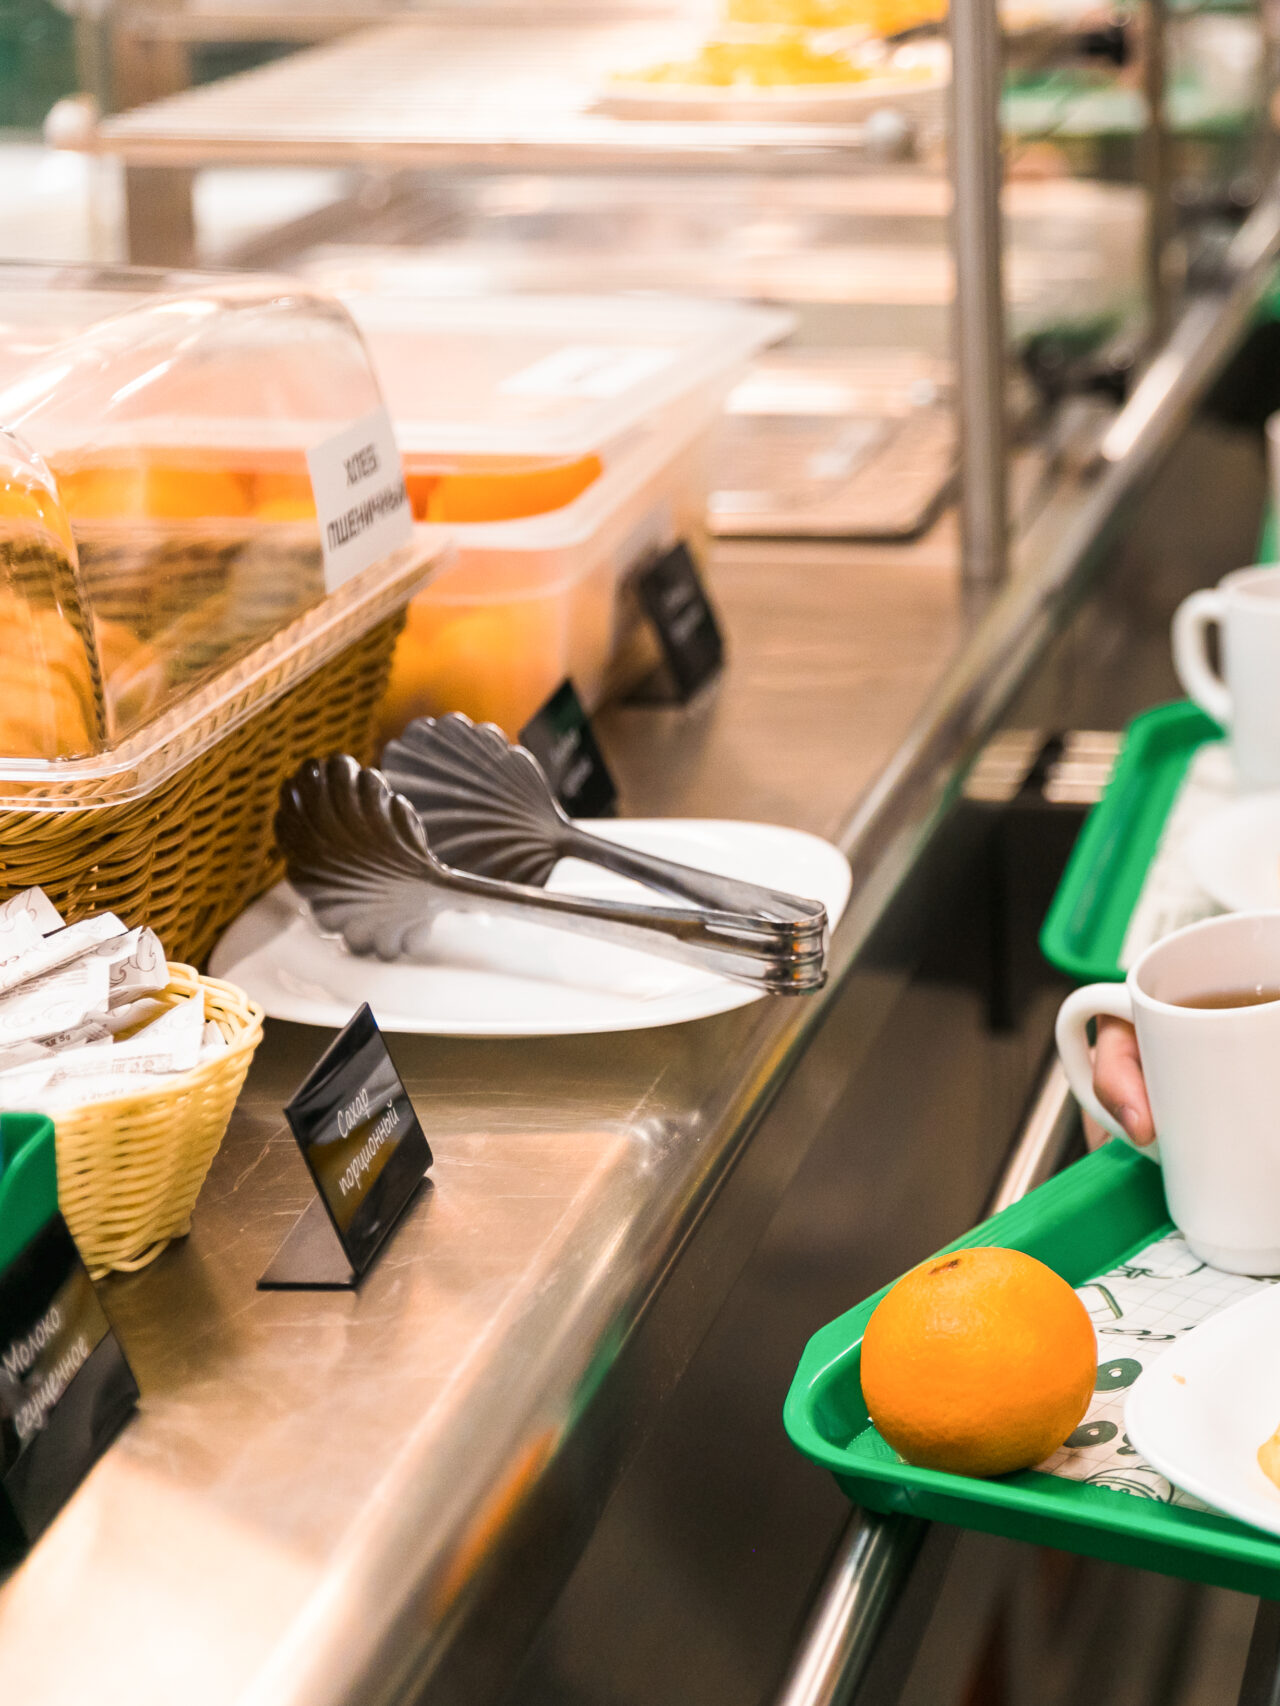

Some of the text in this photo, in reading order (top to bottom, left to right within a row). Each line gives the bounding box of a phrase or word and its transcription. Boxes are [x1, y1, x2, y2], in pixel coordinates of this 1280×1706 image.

[338, 1088, 370, 1138] Сахар
[339, 1099, 400, 1195] порционный
[2, 1306, 60, 1383] Молоко
[15, 1337, 88, 1439] сгущенное
